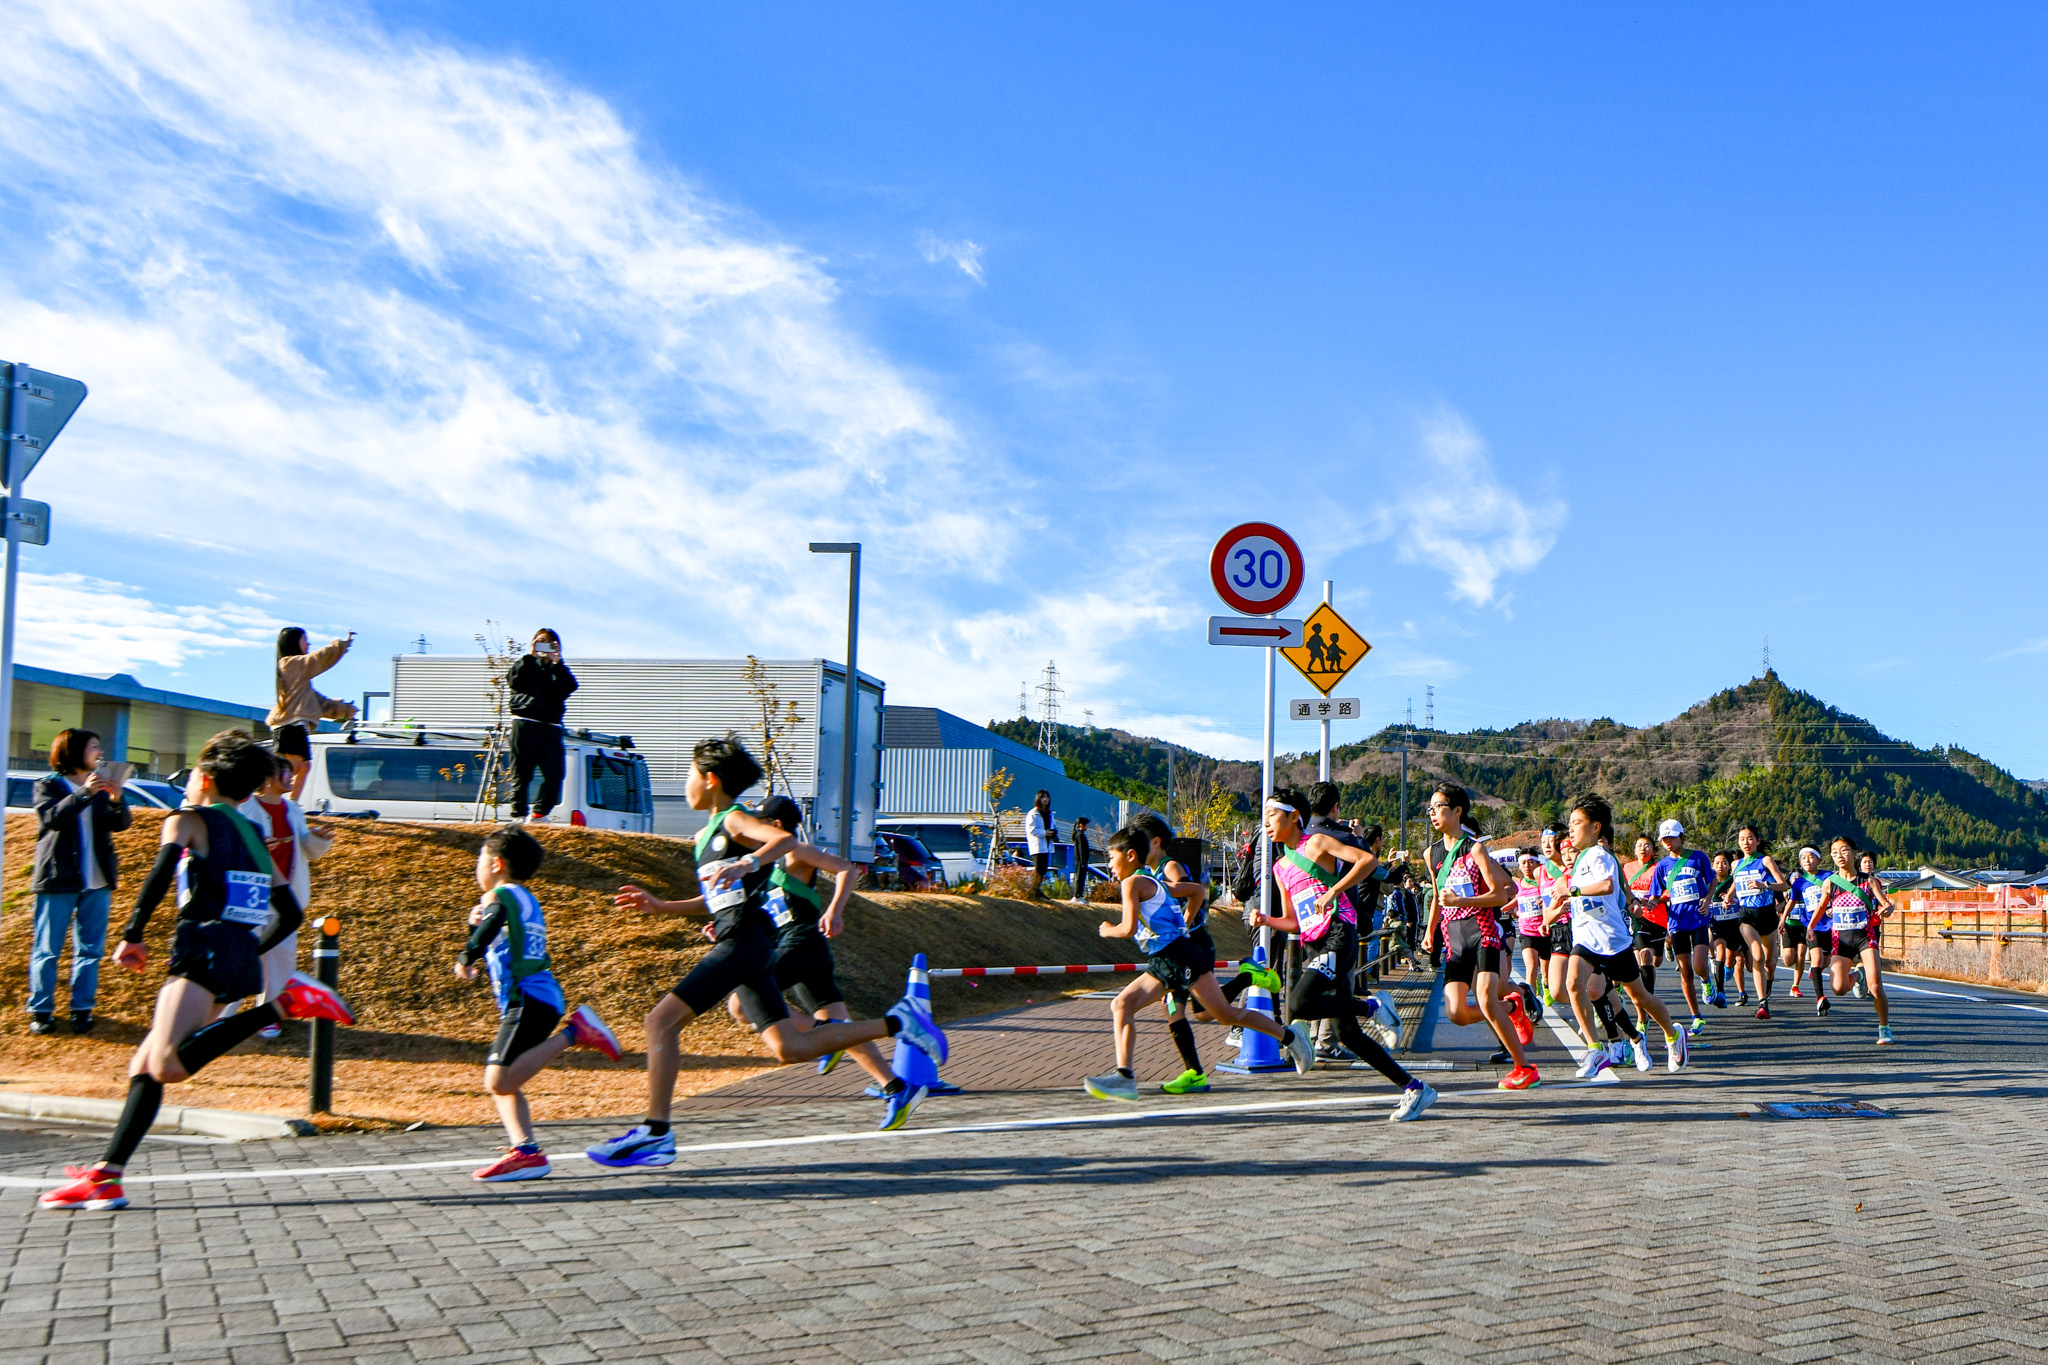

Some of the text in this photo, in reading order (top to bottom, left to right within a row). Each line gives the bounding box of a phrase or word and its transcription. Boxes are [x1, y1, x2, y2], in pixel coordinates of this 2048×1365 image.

[1233, 548, 1283, 588] 30
[1297, 702, 1352, 716] 通学路
[1673, 885, 1694, 897] 38-1
[1718, 904, 1736, 915] 10-1
[1838, 913, 1861, 924] 14-1
[1308, 959, 1337, 980] adidas
